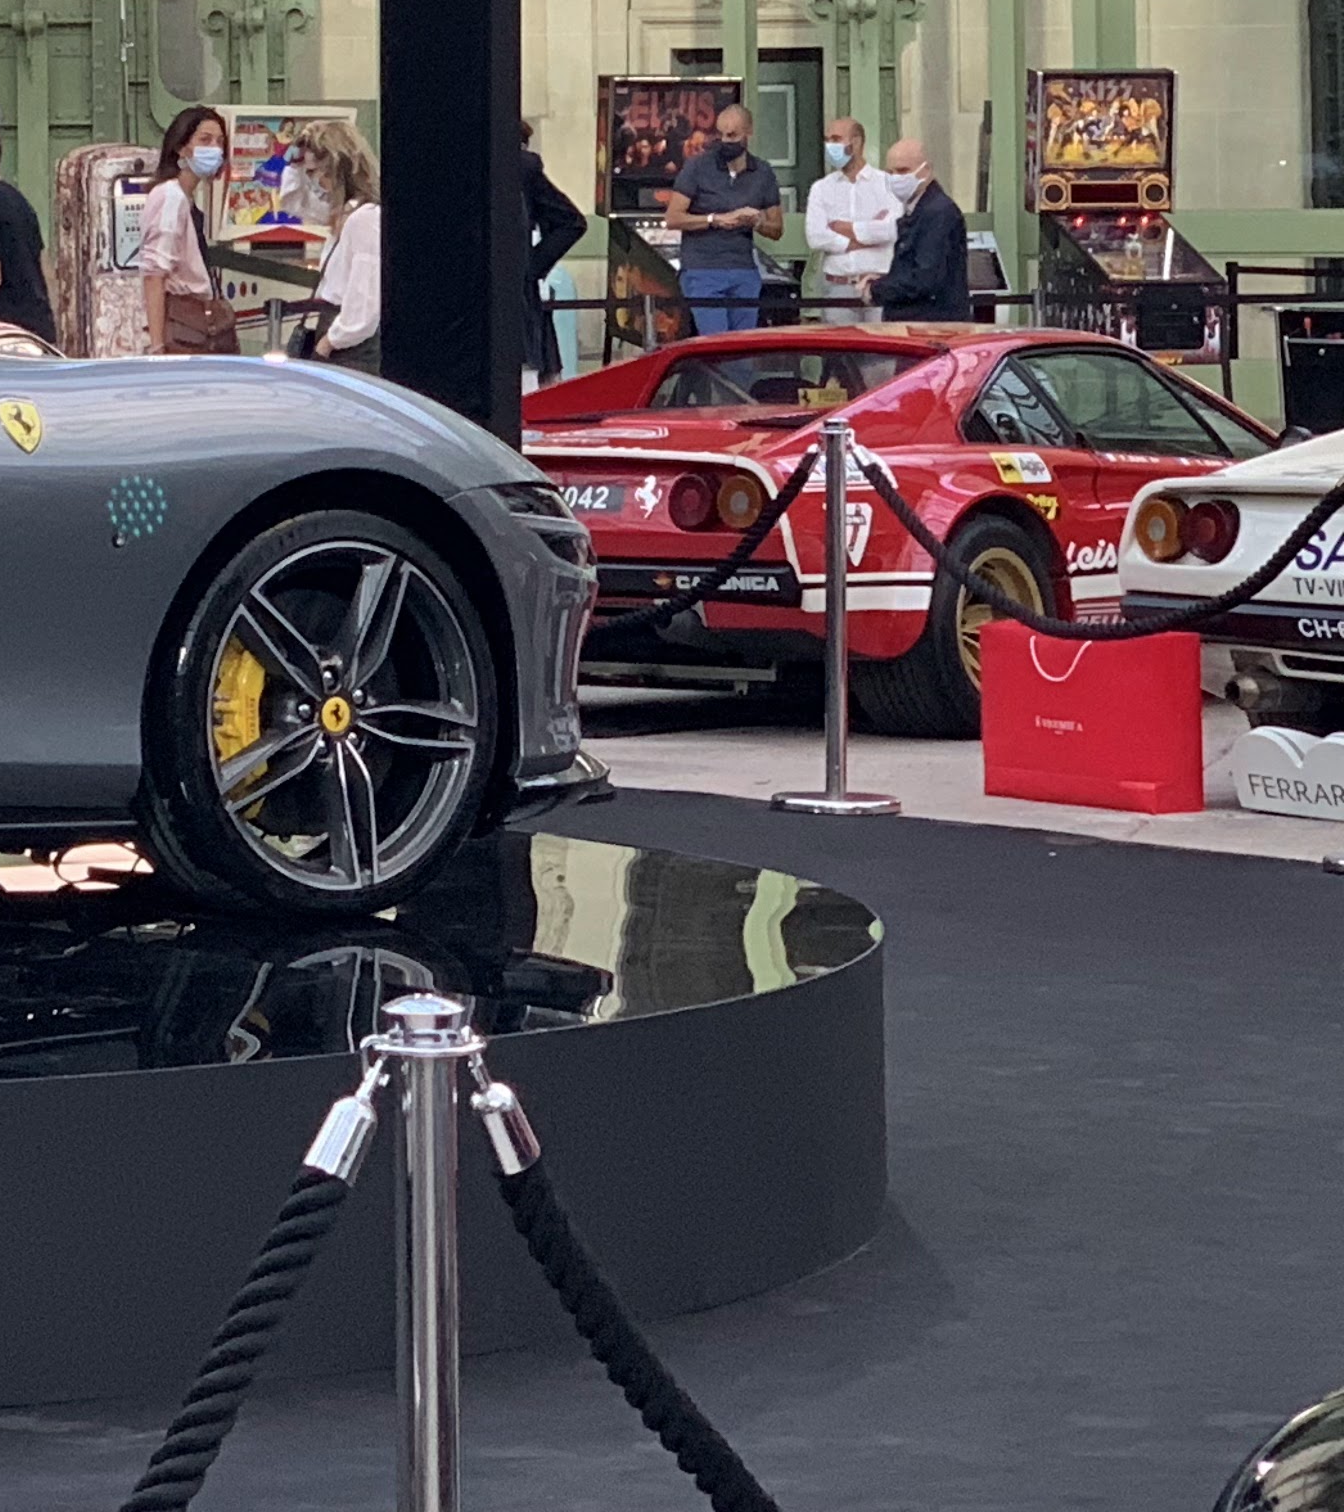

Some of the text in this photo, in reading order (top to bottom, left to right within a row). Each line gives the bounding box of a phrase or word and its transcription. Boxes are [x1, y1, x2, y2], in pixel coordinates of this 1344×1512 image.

[1079, 79, 1133, 101] KISS
[559, 486, 609, 509] 042
[675, 575, 780, 592] CANICA
[1292, 577, 1344, 598] TV-VI
